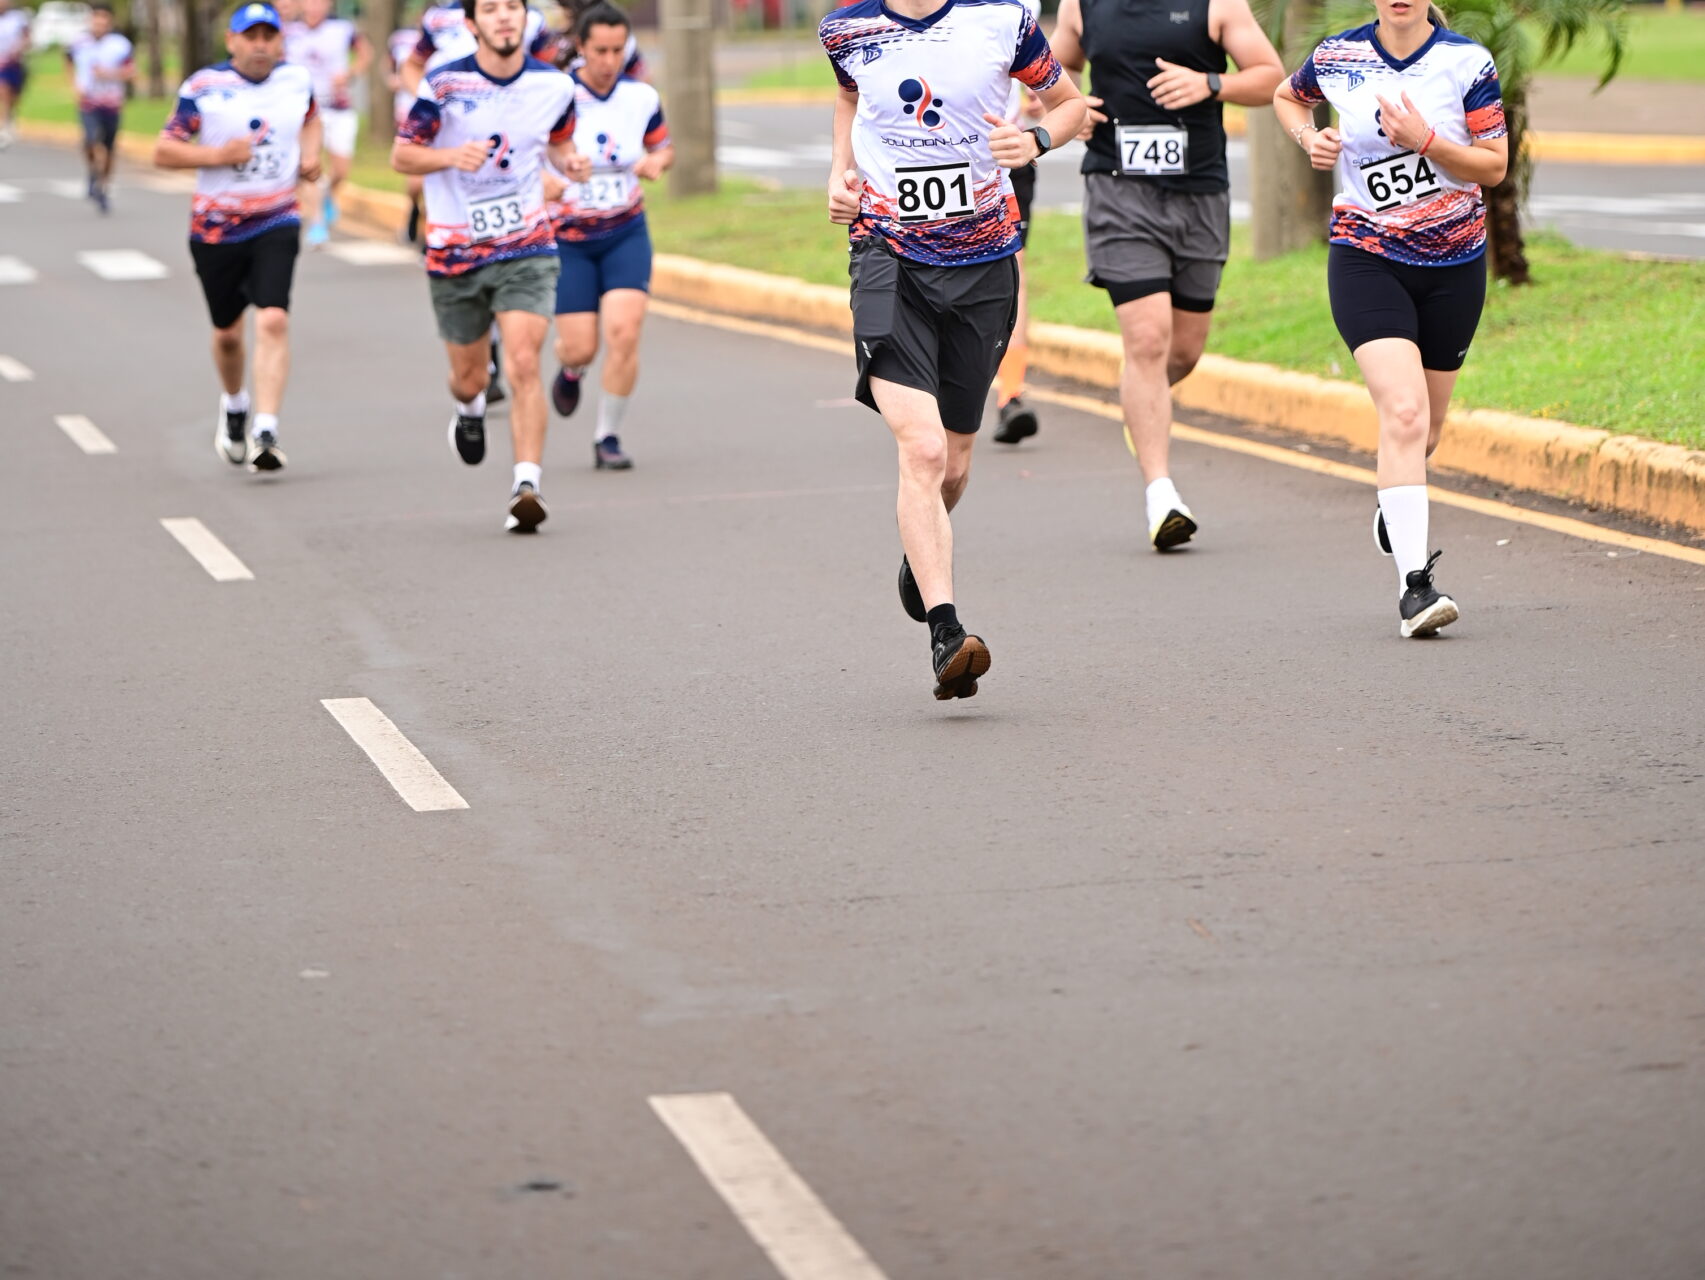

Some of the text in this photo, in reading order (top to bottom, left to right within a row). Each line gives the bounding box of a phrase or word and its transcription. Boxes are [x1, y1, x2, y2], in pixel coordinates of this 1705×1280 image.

[1124, 140, 1180, 165] 748
[897, 173, 968, 212] 801
[1367, 156, 1436, 202] 654
[471, 201, 523, 233] 833
